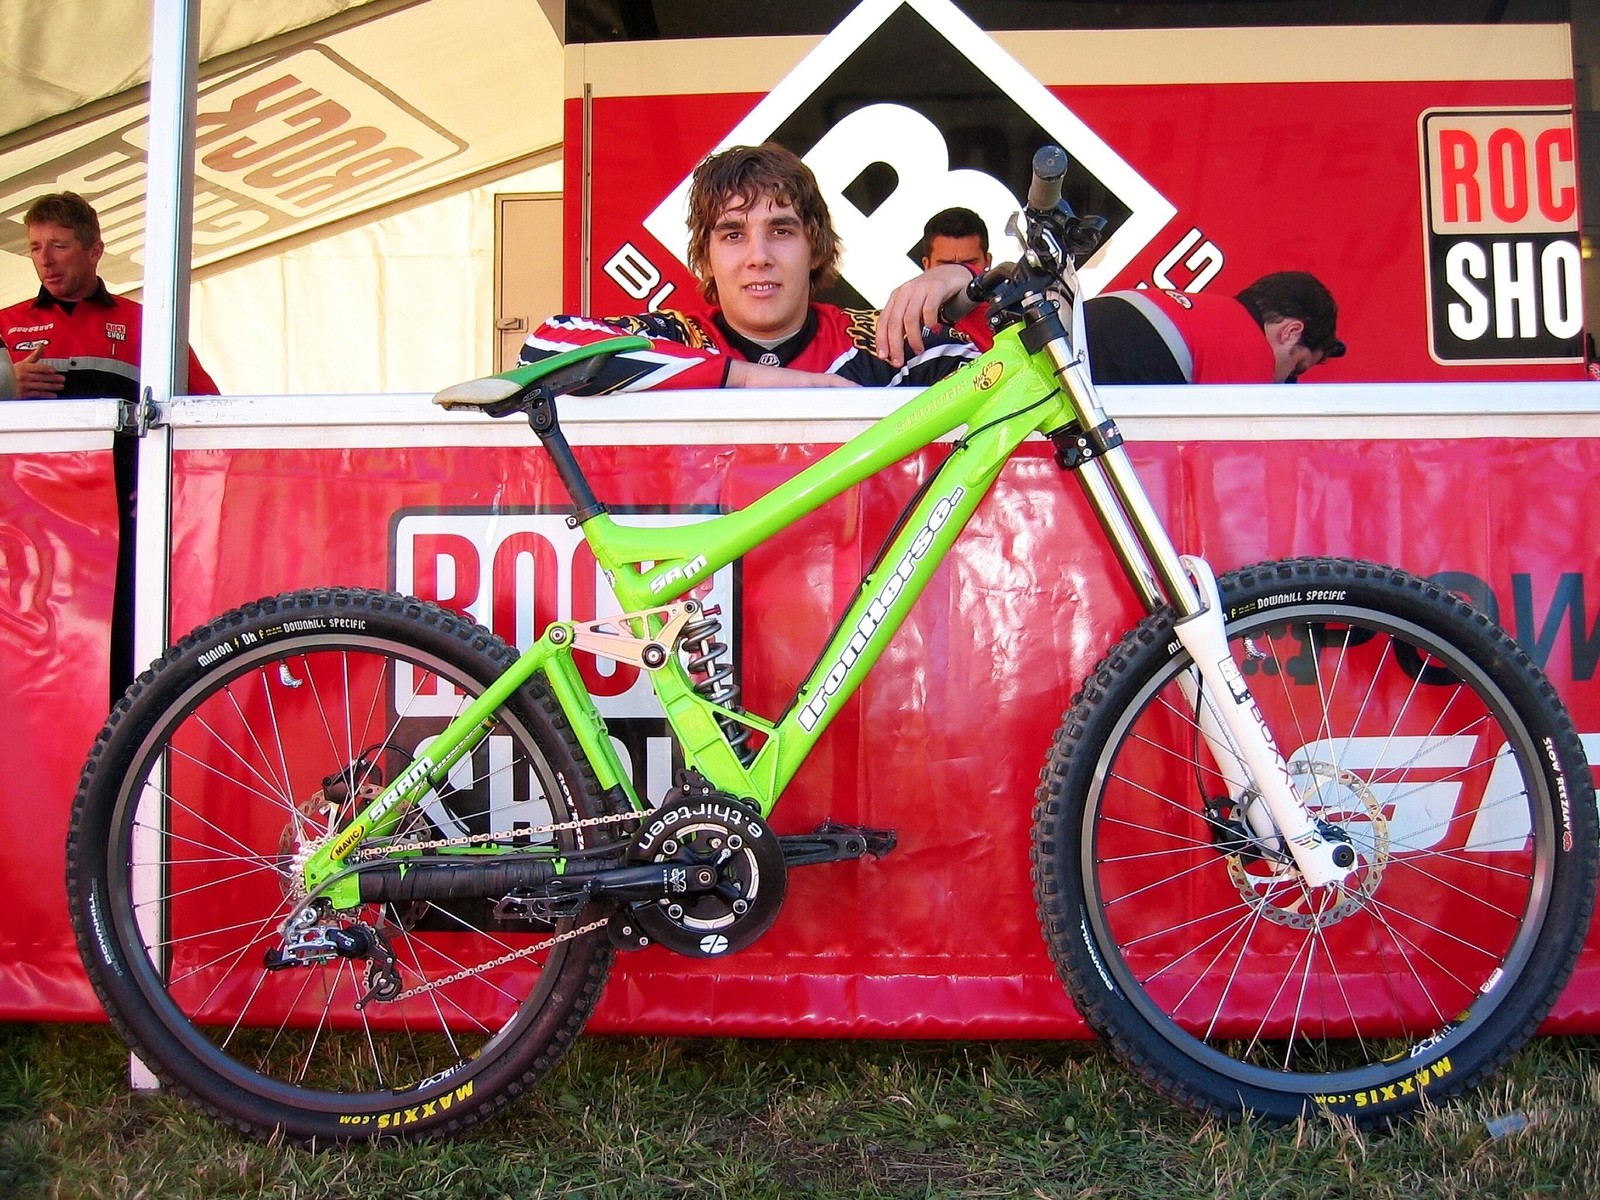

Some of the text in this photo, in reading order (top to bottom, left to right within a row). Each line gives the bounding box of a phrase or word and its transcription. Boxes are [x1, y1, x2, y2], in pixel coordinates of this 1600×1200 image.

[1446, 240, 1584, 341] SHO
[412, 532, 714, 697] ROC
[369, 756, 434, 821] SRAM
[335, 830, 360, 857] MAVIC
[638, 803, 764, 850] e.thirteen
[88, 892, 113, 965] DOWNHILL
[1080, 919, 1114, 991] DOWNHILL
